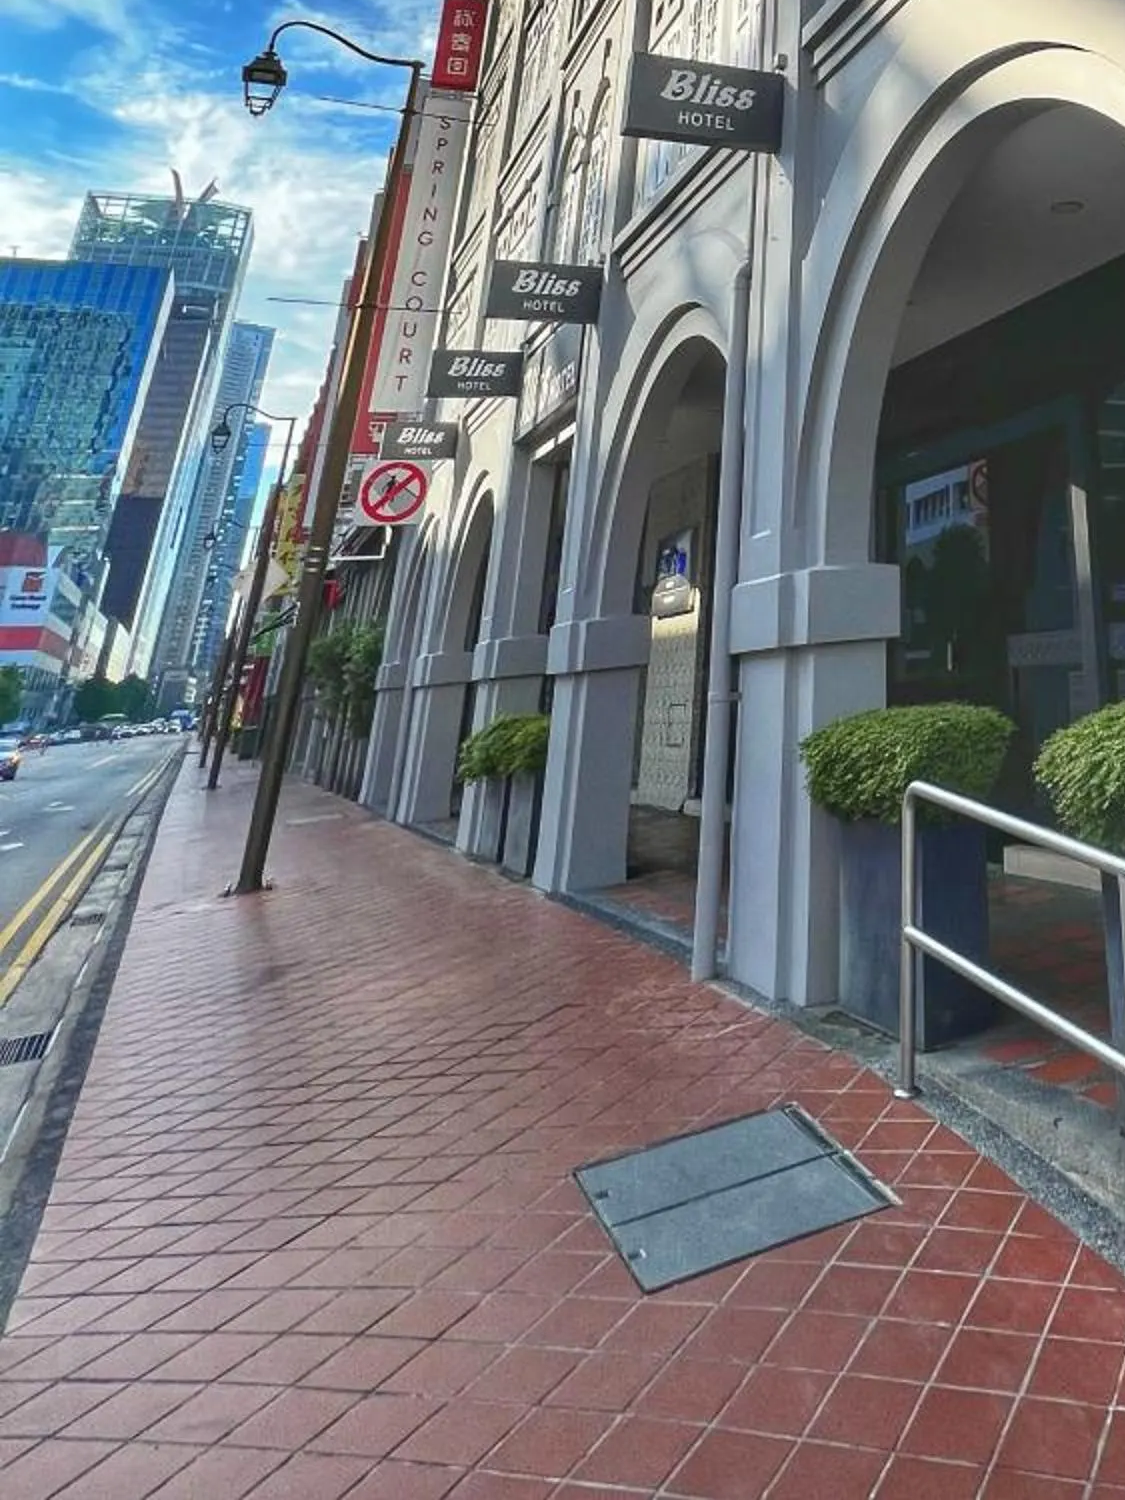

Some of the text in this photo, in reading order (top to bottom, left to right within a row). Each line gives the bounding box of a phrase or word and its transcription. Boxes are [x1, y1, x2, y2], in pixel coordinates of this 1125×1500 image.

[660, 69, 757, 110] Bliss
[678, 111, 736, 131] HOTEL
[395, 116, 452, 392] SPRING COURT
[512, 269, 582, 297] Bliss
[523, 299, 566, 313] HOTEL
[447, 356, 507, 377] Bliss
[457, 381, 492, 391] HOTEL
[396, 427, 446, 444] Bliss
[404, 447, 433, 455] HOTEL
